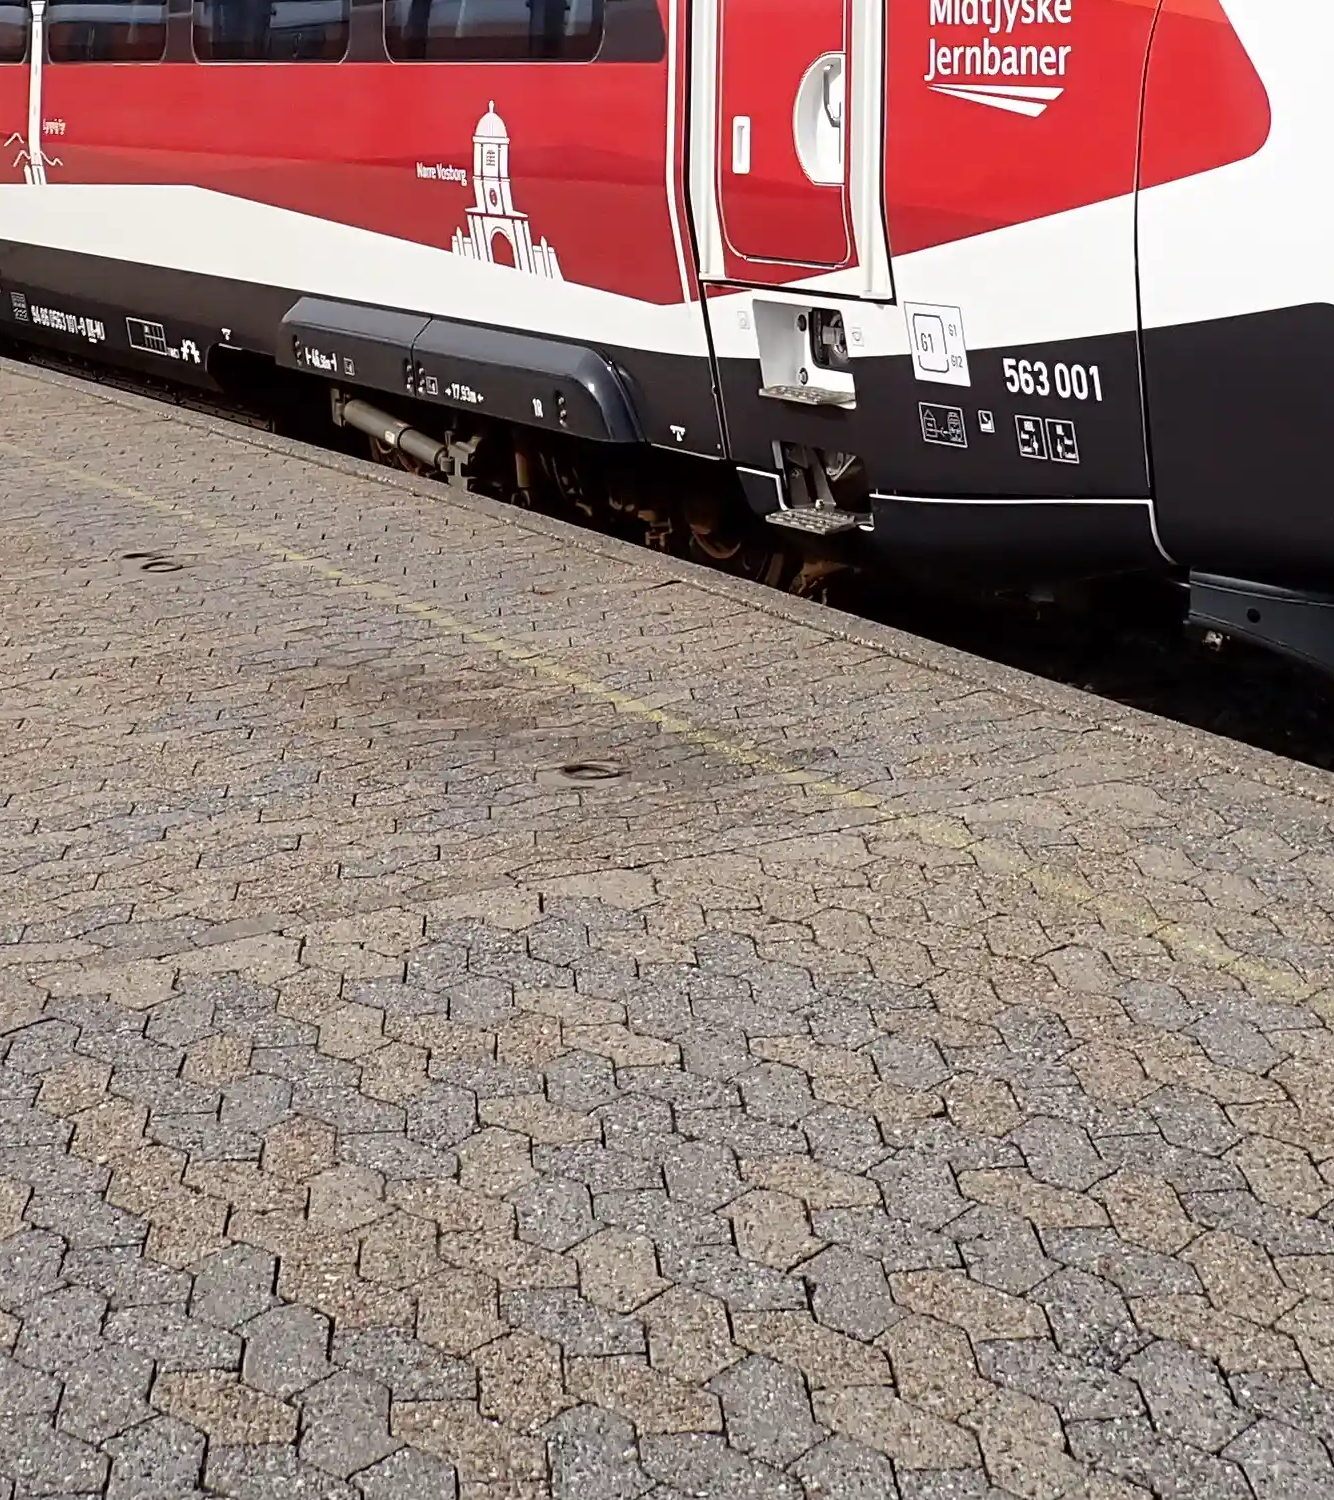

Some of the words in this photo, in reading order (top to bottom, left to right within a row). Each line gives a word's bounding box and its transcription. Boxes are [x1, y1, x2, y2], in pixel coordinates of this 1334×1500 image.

[923, 37, 1072, 81] Jernbaner
[920, 332, 934, 353] G1
[948, 323, 958, 337] G1
[1002, 357, 1051, 397] 563
[1054, 362, 1103, 402] 001
